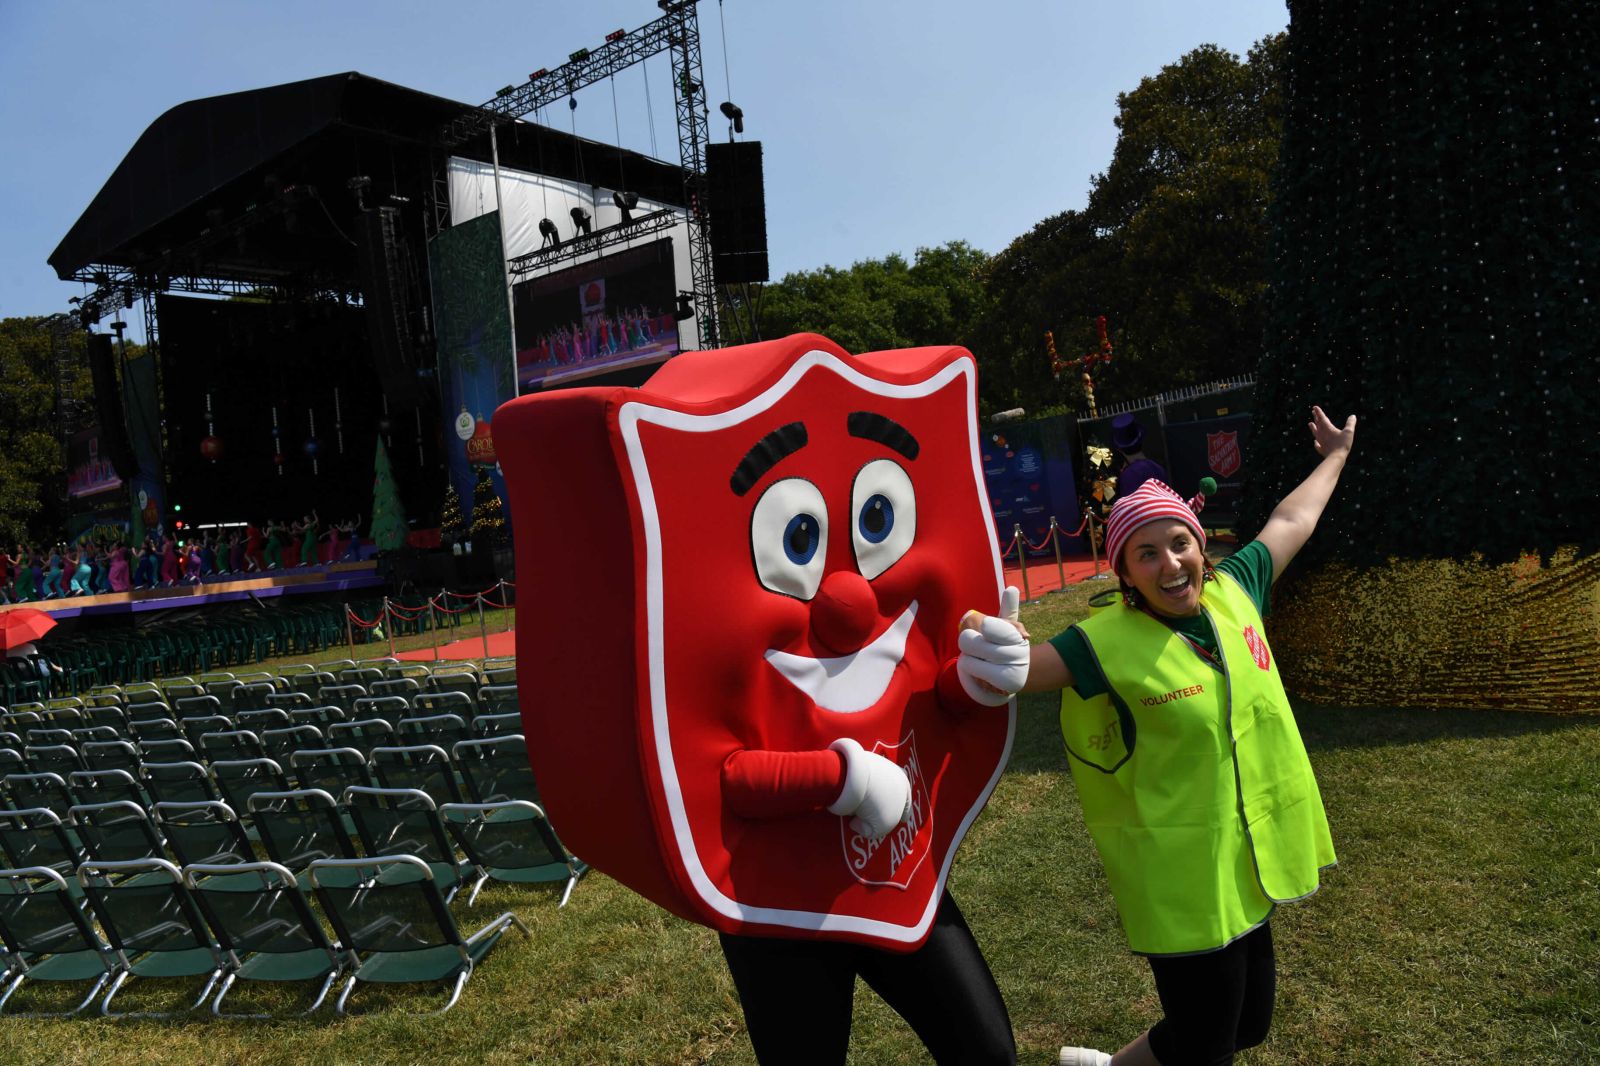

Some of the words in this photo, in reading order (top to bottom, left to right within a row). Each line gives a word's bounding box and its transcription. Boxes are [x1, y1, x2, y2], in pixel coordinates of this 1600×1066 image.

[467, 437, 494, 454] CAROL
[1140, 684, 1204, 707] VOLUNTEER
[890, 789, 923, 879] ARMY
